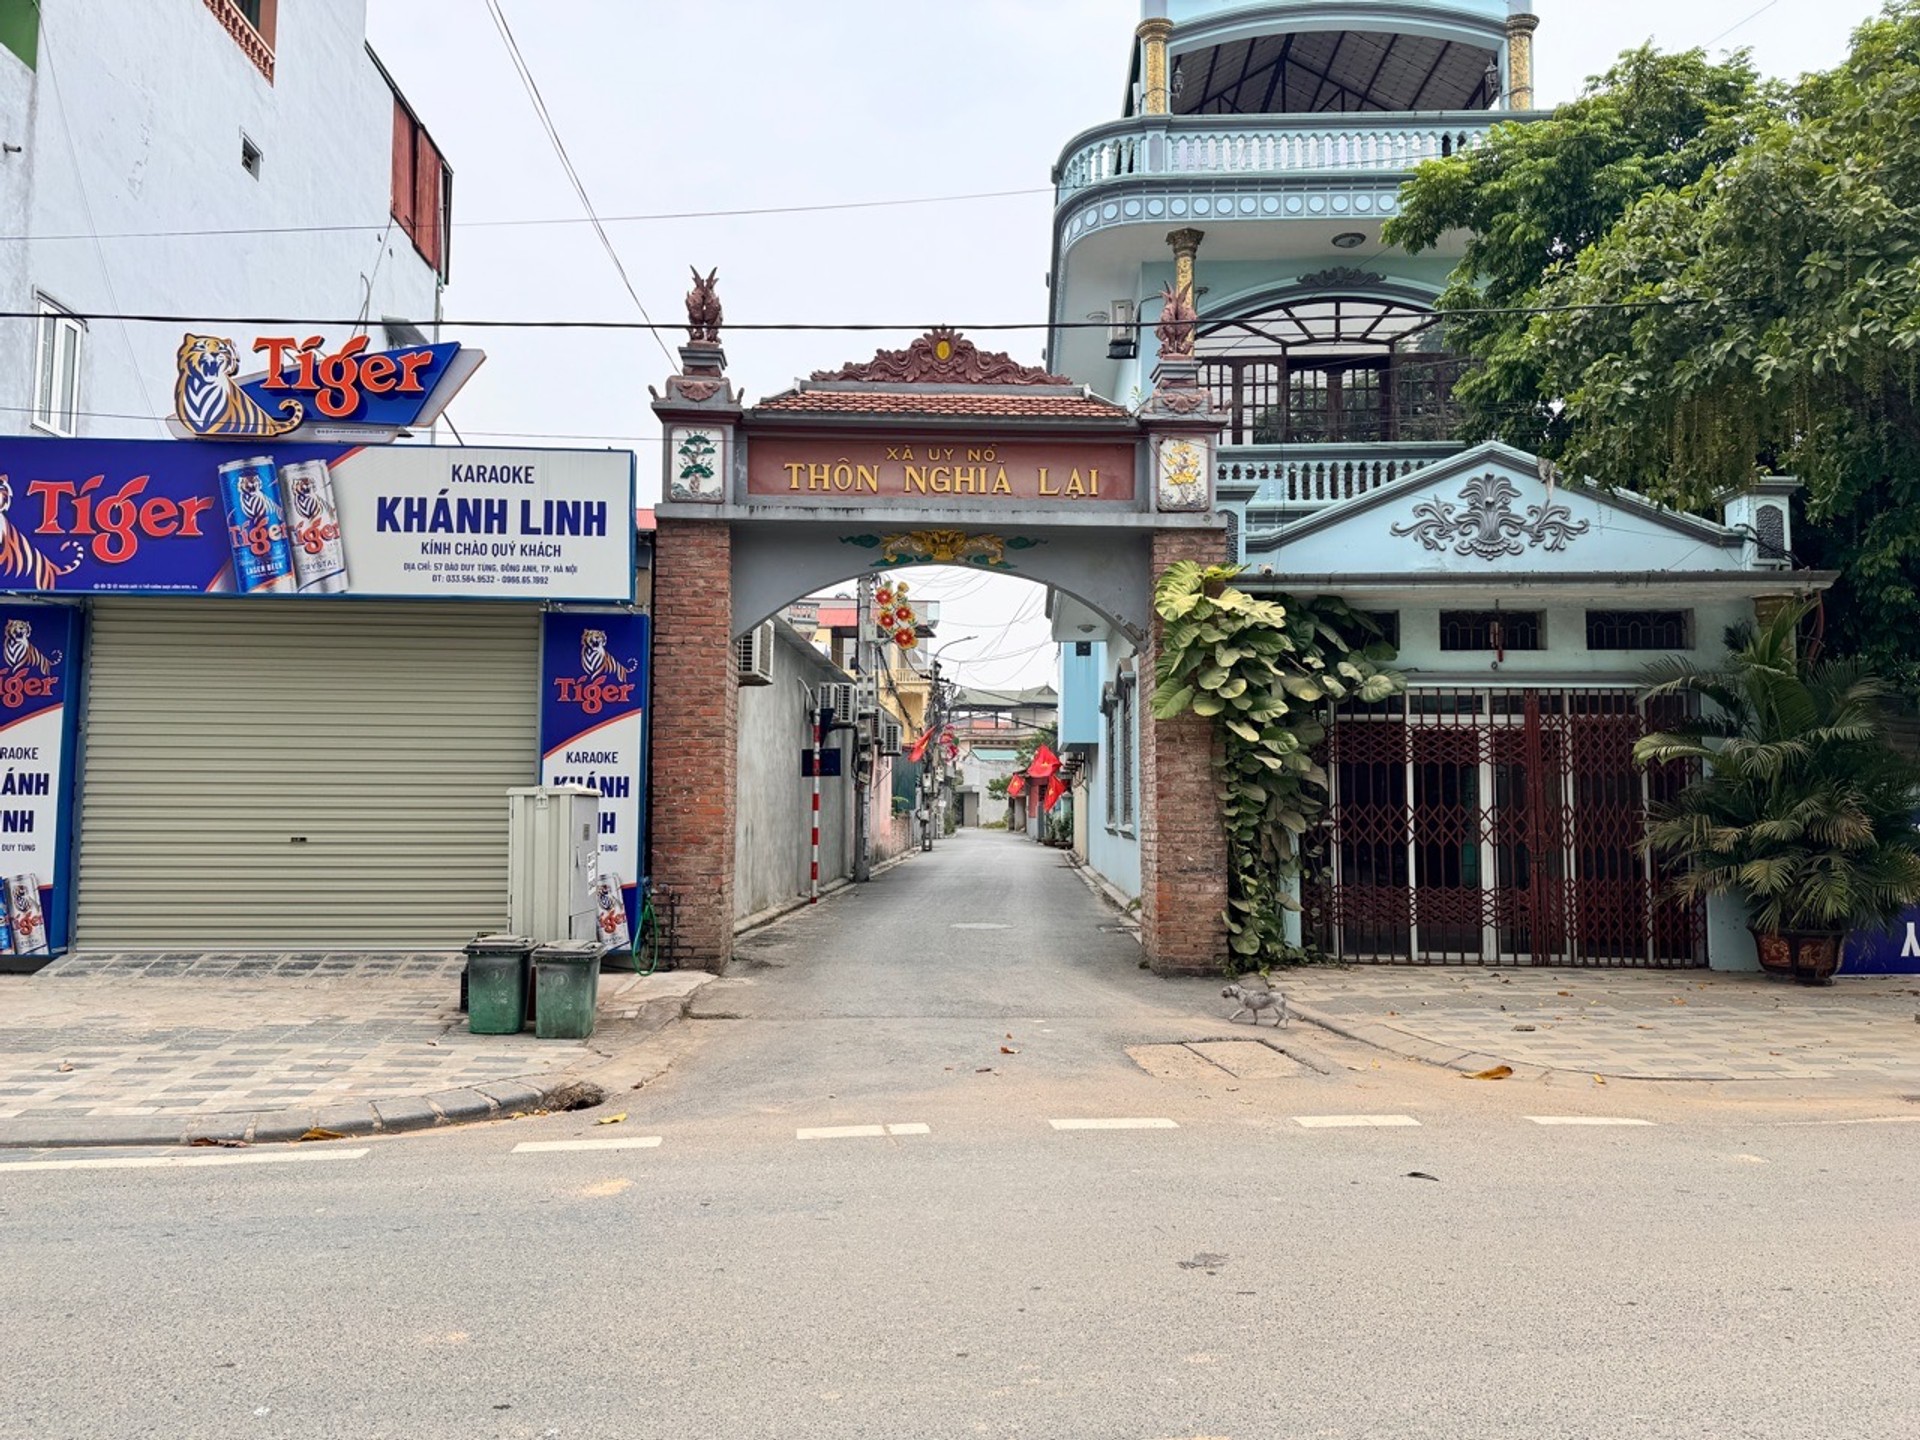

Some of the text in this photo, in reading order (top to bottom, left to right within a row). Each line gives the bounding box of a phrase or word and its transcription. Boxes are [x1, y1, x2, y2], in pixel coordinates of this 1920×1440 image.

[252, 334, 434, 418] Tiger
[886, 444, 914, 460] XÃ
[928, 448, 954, 461] UY
[451, 464, 535, 484] KARAOKE
[784, 457, 879, 494] THÔN
[1038, 467, 1099, 499] LẠI
[26, 474, 215, 564] Tiger
[376, 488, 608, 537] KHÁNH LINH
[421, 538, 562, 557] KÍNH CHÀO QUÝ KHÁCH
[433, 562, 443, 572] 57
[460, 563, 475, 572] DUY
[553, 675, 635, 714] Tiger
[0, 746, 39, 760] RAOKE
[566, 751, 618, 764] KARAOKE
[0, 767, 50, 796] ÁNH
[2, 843, 16, 852] DUY
